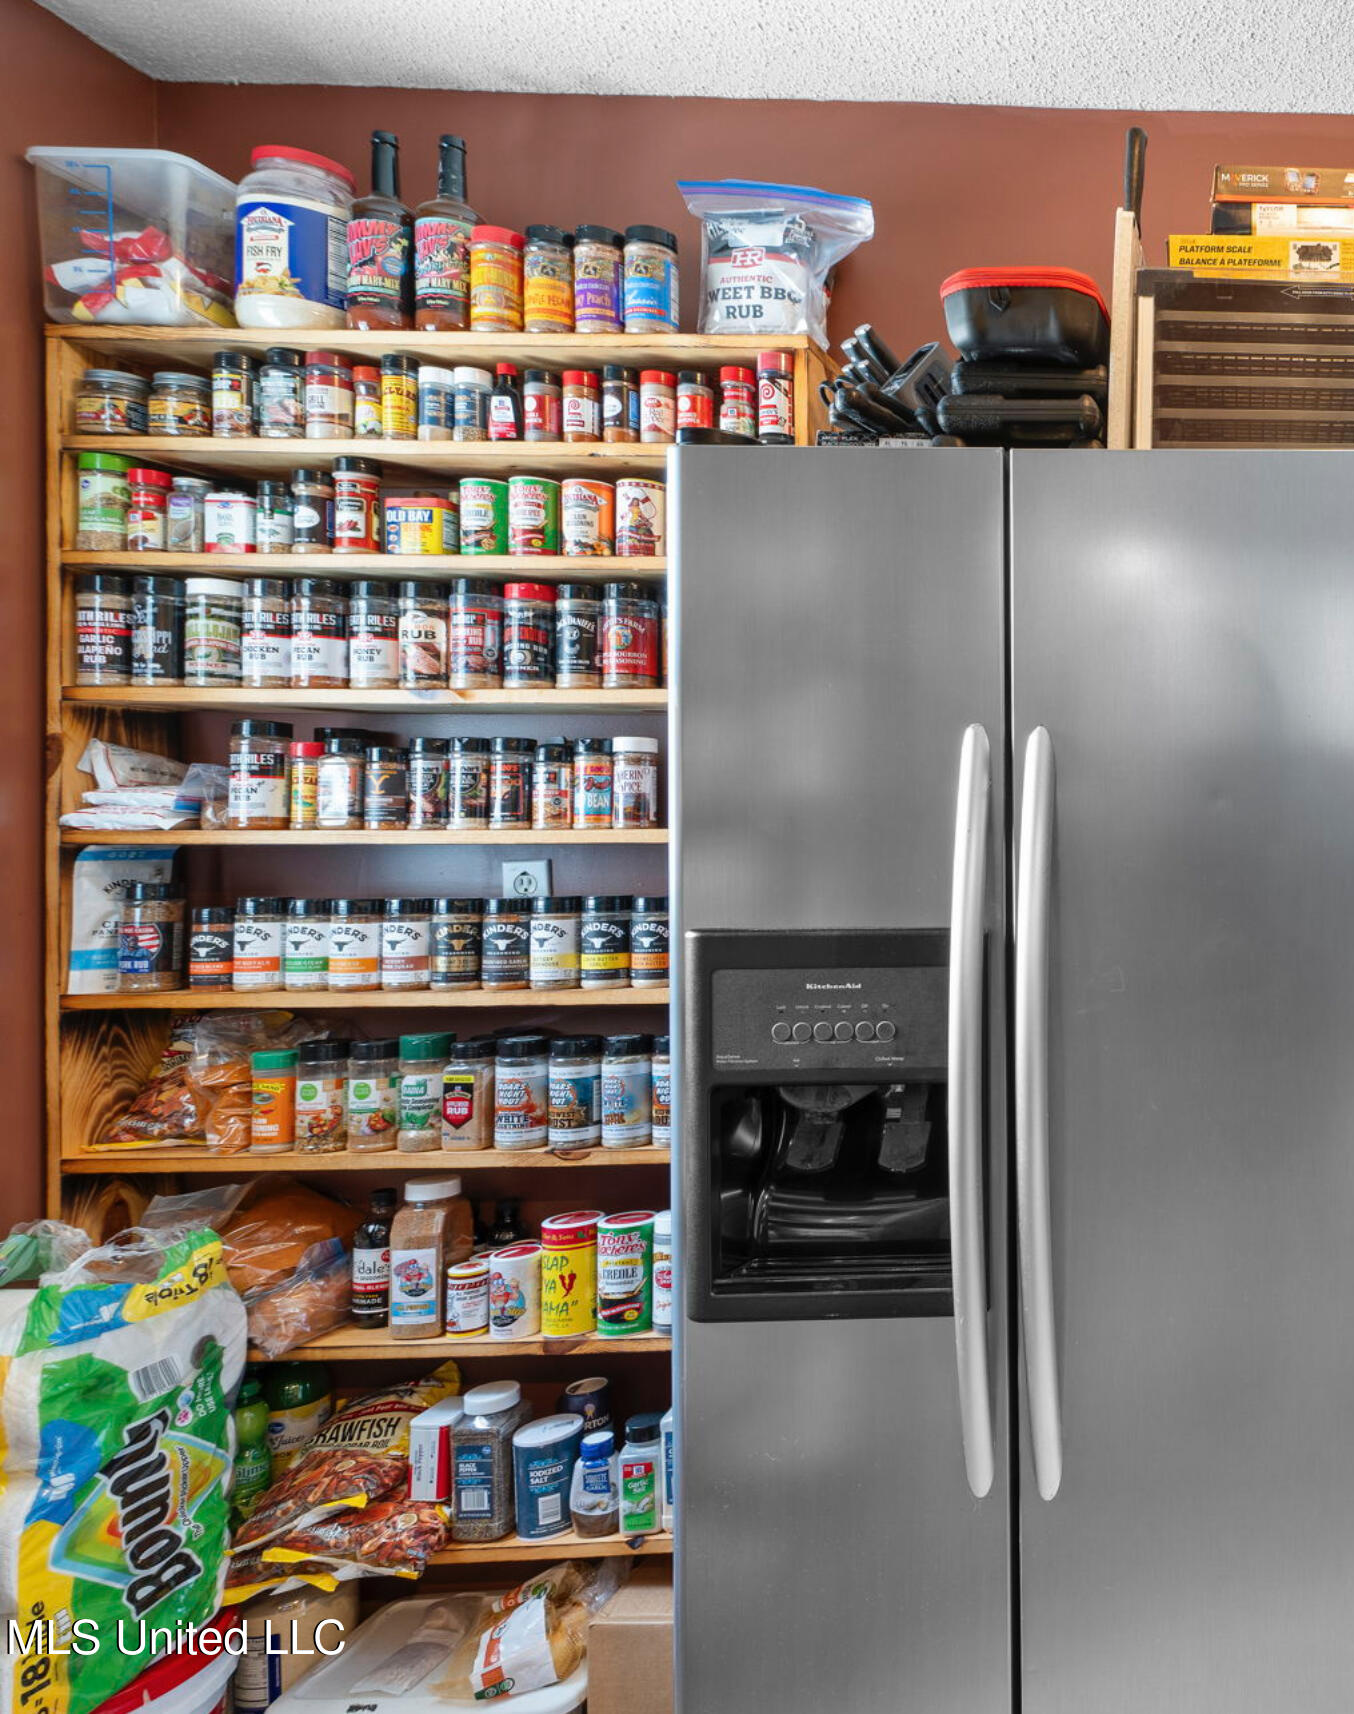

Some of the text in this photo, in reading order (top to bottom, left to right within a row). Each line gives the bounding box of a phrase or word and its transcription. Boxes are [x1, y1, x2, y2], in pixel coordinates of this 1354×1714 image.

[247, 246, 281, 257] FISH FRY
[1179, 245, 1254, 254] PLATFORM SCALE
[1179, 257, 1219, 266] BALANCE
[1227, 258, 1282, 267] PLATEFORME
[719, 275, 774, 285] AUTHENTIC
[708, 286, 802, 305] WEET BBQ
[726, 304, 764, 320] RUB
[386, 509, 430, 522] OLD BAY
[261, 612, 290, 625] RILES
[307, 613, 337, 626] RILES
[367, 614, 396, 627] RILES
[401, 630, 437, 640] RUB
[84, 655, 107, 663] RUB
[587, 793, 610, 808] BEAN
[235, 924, 272, 942] NDER'S
[288, 925, 325, 942] NDER'S
[331, 925, 368, 943] NDER'S
[384, 924, 423, 941] NDER'S
[533, 922, 567, 938] NDER'S
[191, 935, 231, 949] NDER'S
[806, 982, 862, 990] KitchenAid
[446, 1107, 469, 1115] RUB
[496, 1114, 529, 1124] WHITE
[602, 1267, 638, 1279] CREOLE
[144, 1283, 199, 1307] Triple
[584, 1415, 609, 1431] RTON
[305, 1417, 402, 1446] RAWFISH
[529, 1465, 564, 1479] IODIZED
[529, 1476, 549, 1485] SALT
[100, 1410, 201, 1616] Bounty
[20, 1656, 51, 1707] 18
